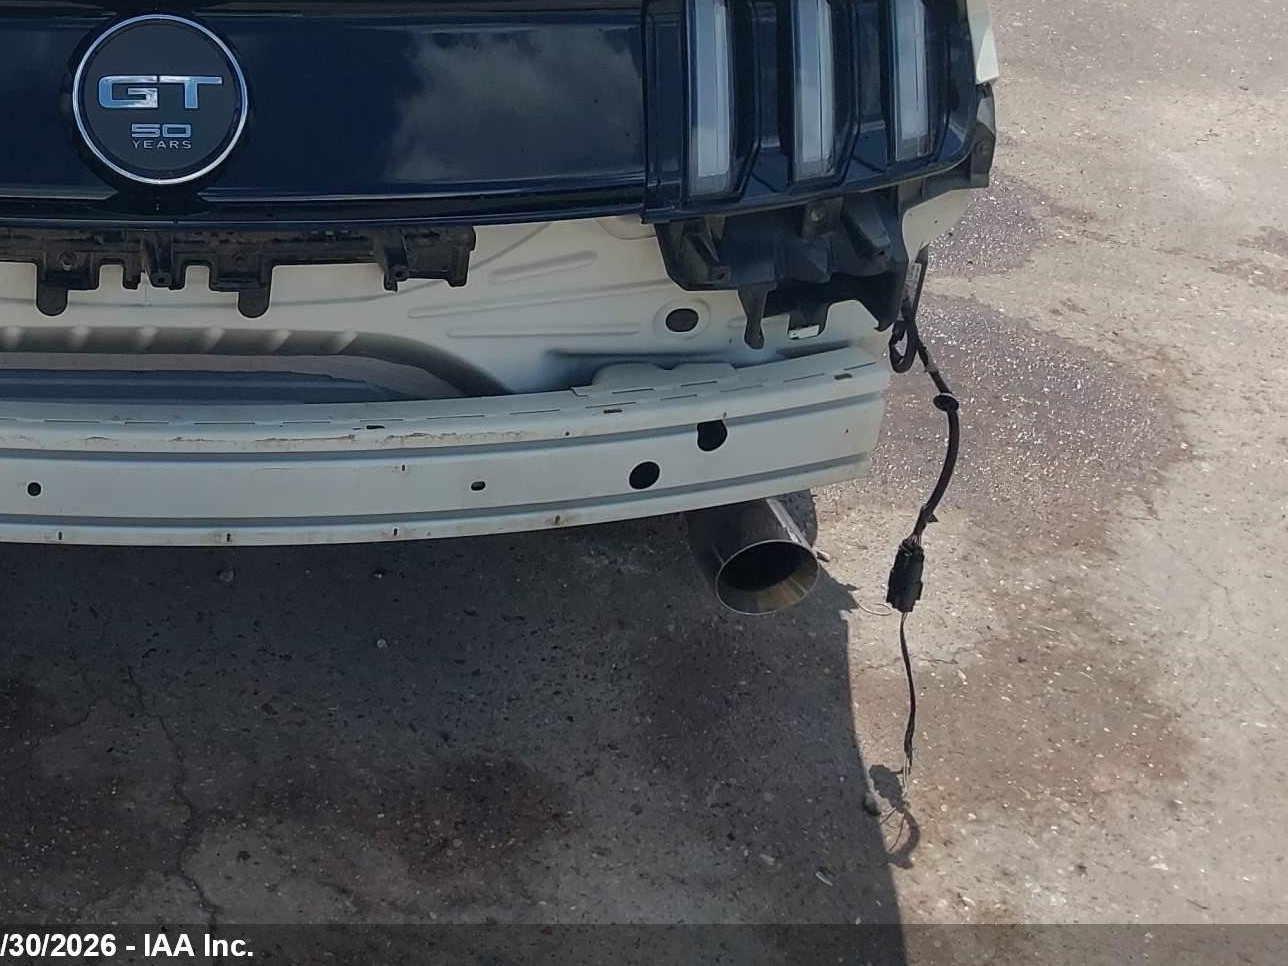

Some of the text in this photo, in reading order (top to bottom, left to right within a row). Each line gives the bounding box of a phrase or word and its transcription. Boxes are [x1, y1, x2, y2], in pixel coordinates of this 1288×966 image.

[98, 75, 222, 109] GT
[131, 123, 192, 138] 50
[132, 139, 192, 149] YEARS
